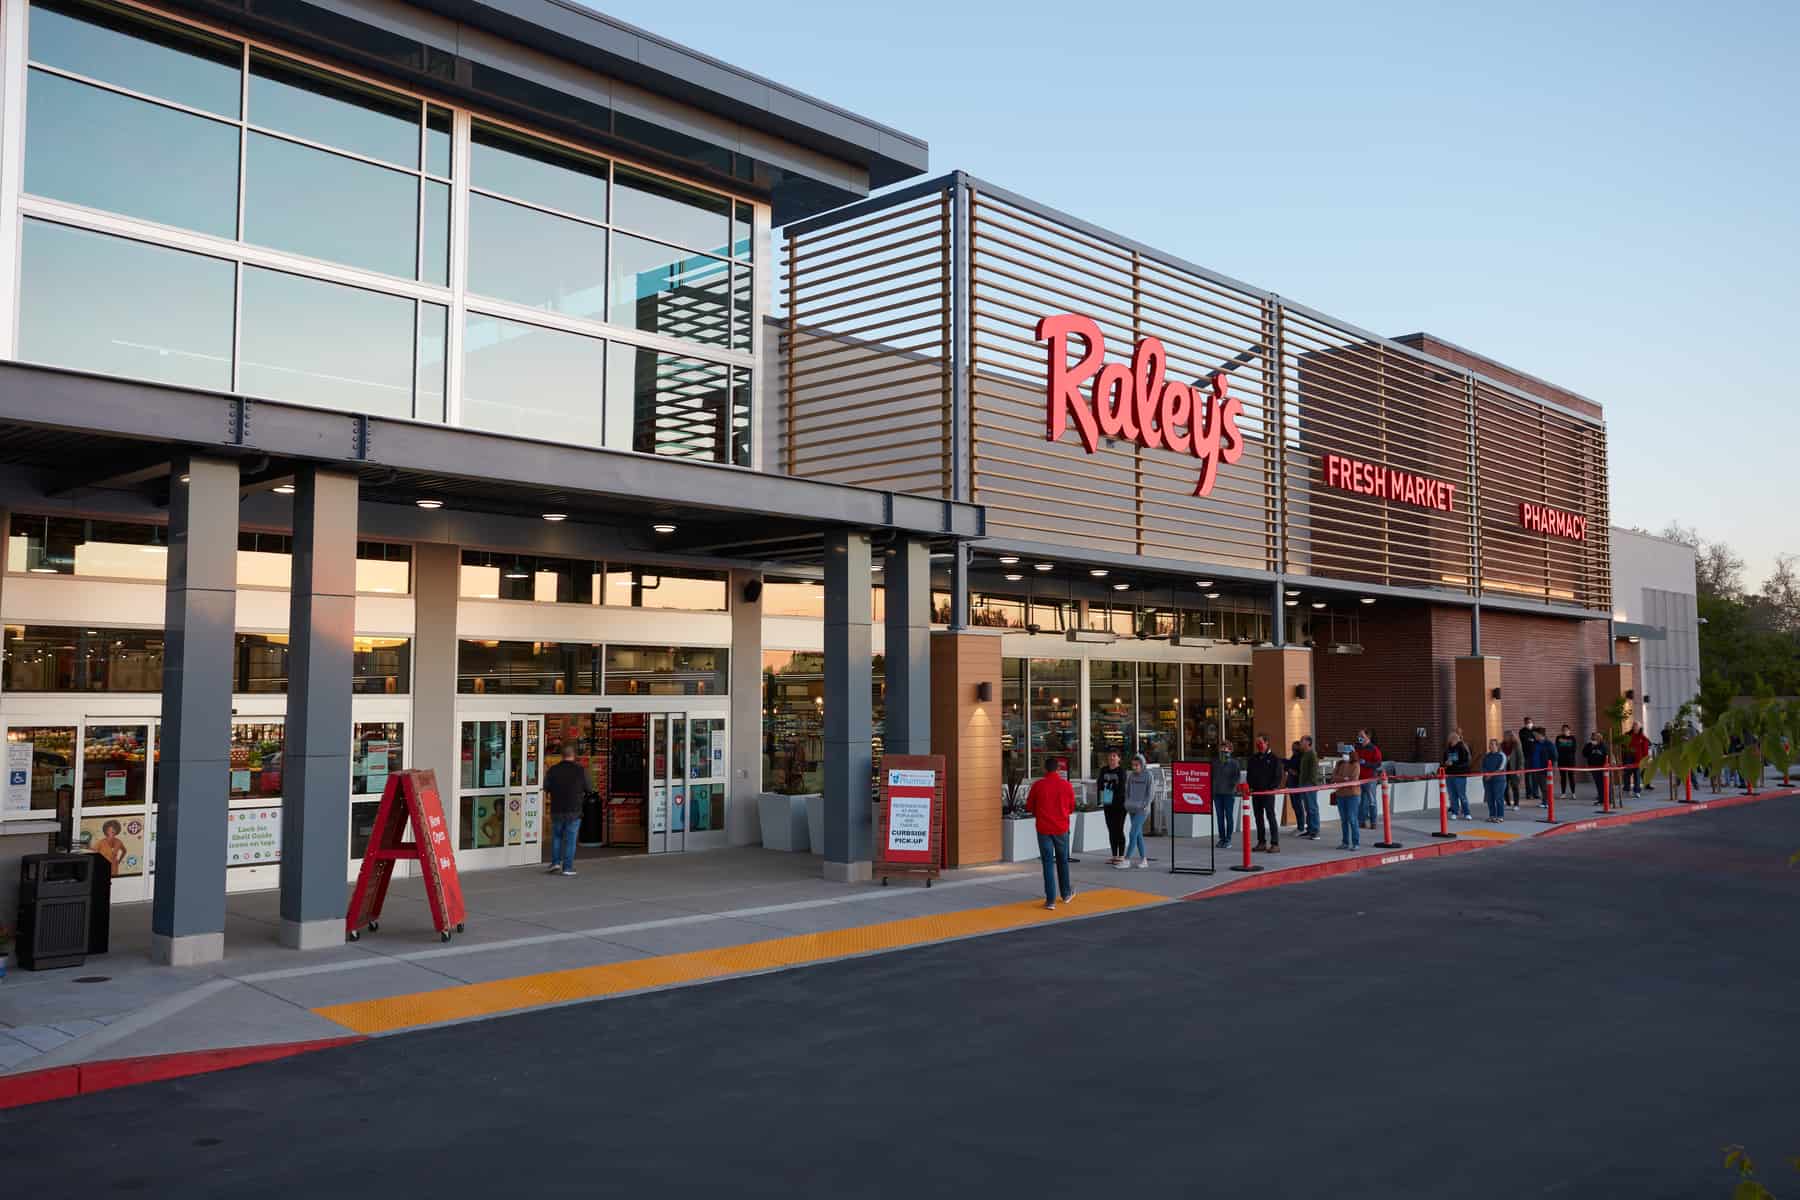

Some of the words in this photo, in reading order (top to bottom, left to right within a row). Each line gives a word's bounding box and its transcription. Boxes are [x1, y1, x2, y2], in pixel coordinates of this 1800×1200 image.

[1036, 314, 1244, 496] Raley's
[1325, 454, 1386, 497] FRESH
[1391, 471, 1456, 512] MARKET
[1521, 503, 1586, 541] PHARMACY
